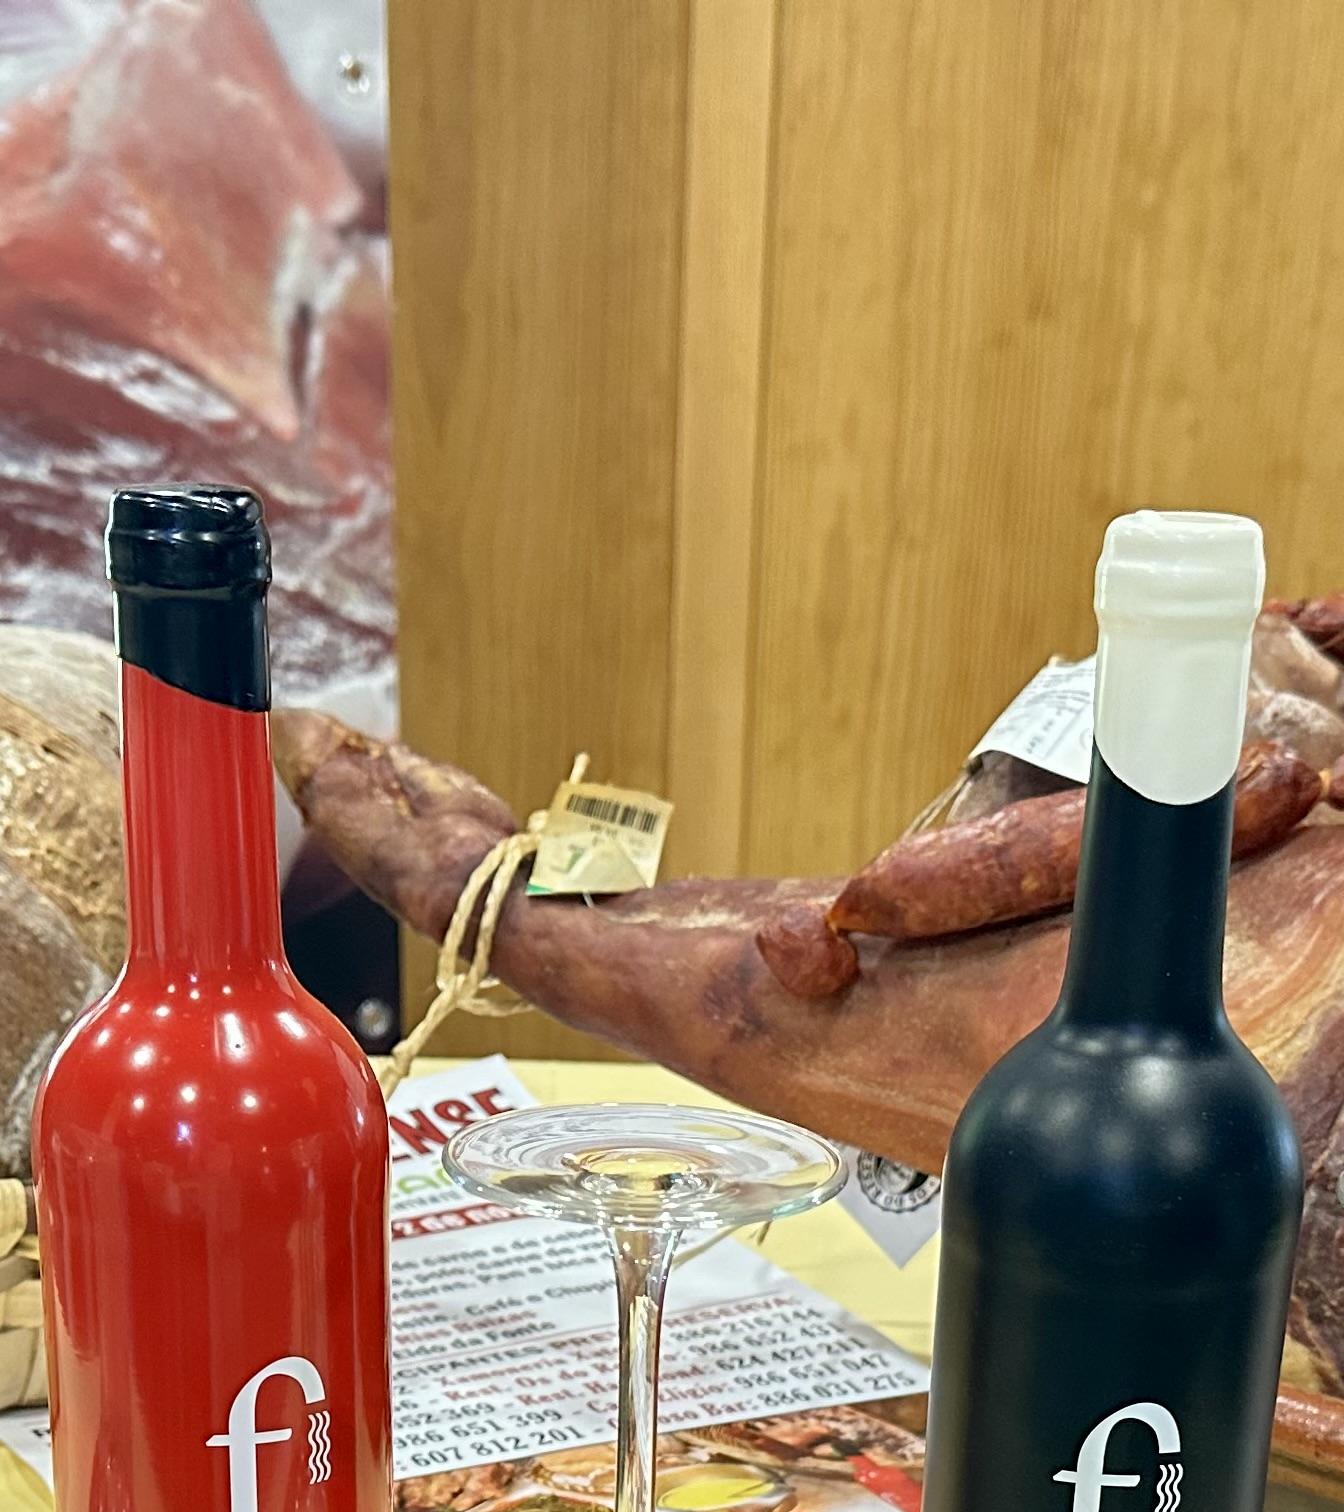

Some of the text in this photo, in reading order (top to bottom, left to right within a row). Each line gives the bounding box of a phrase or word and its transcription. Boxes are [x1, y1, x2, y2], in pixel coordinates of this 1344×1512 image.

[450, 1408, 562, 1439] 651 399
[411, 1425, 585, 1468] 607 812 201
